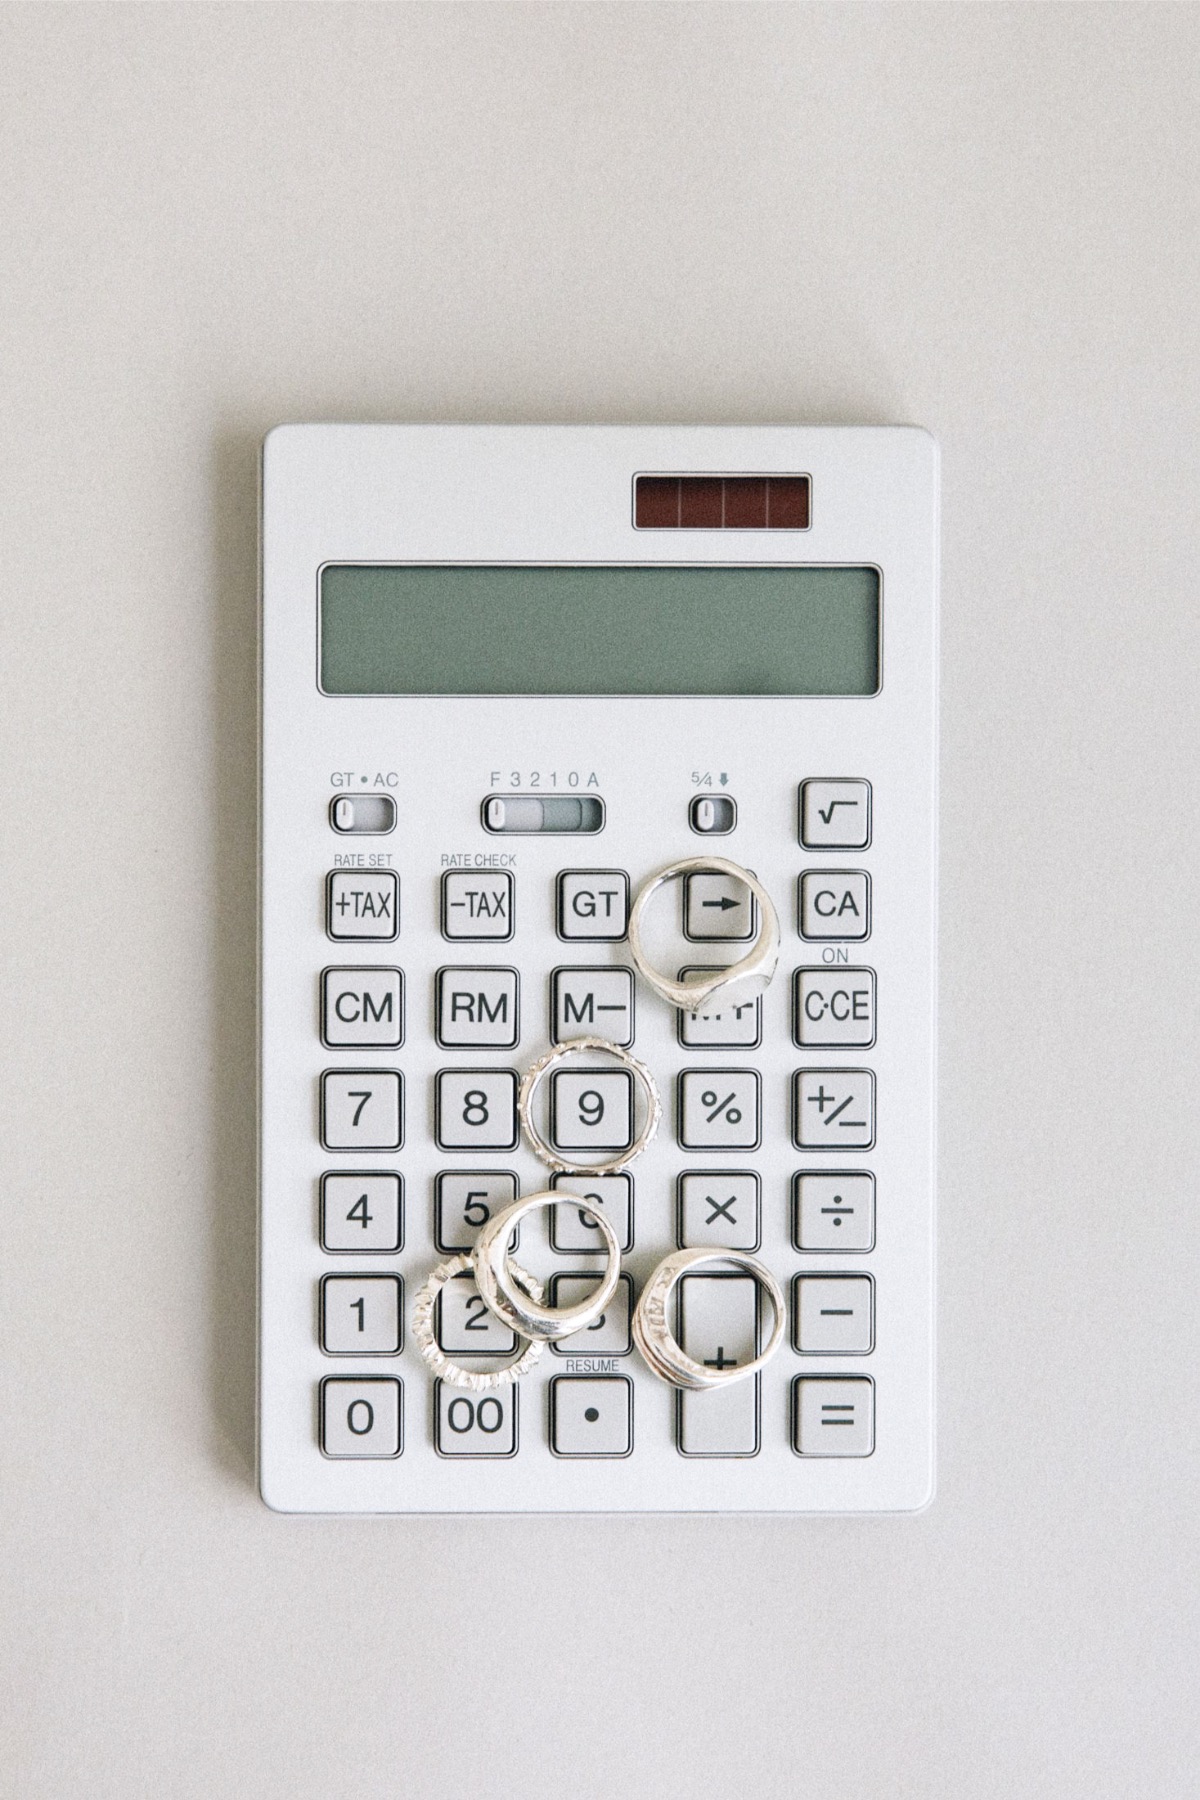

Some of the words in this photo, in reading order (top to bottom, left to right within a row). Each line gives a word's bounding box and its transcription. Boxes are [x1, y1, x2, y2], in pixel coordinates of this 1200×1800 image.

[330, 772, 354, 788] GT
[374, 772, 399, 788] AC
[490, 771, 501, 788] F
[510, 771, 521, 788] 3
[530, 771, 541, 788] 2
[550, 771, 557, 787] 1
[568, 771, 579, 788] 0
[587, 771, 600, 787] A
[334, 853, 366, 867] RATE
[368, 853, 393, 867] SET
[440, 853, 472, 867] RATE
[474, 853, 517, 867] CHECK
[335, 891, 391, 918] +TAX
[572, 890, 619, 918] GT
[813, 890, 860, 917] CA
[821, 947, 849, 964] ON
[335, 991, 393, 1023] CM
[450, 991, 508, 1023] RM
[347, 1091, 373, 1127] 7
[462, 1090, 489, 1126] 8
[578, 1090, 605, 1126] 9
[346, 1193, 374, 1229] 4
[463, 1191, 490, 1227] 5
[349, 1297, 365, 1332] 1
[464, 1295, 490, 1331] 2
[566, 1358, 620, 1372] RESUME
[347, 1399, 374, 1435] 0
[447, 1396, 504, 1434] 00
